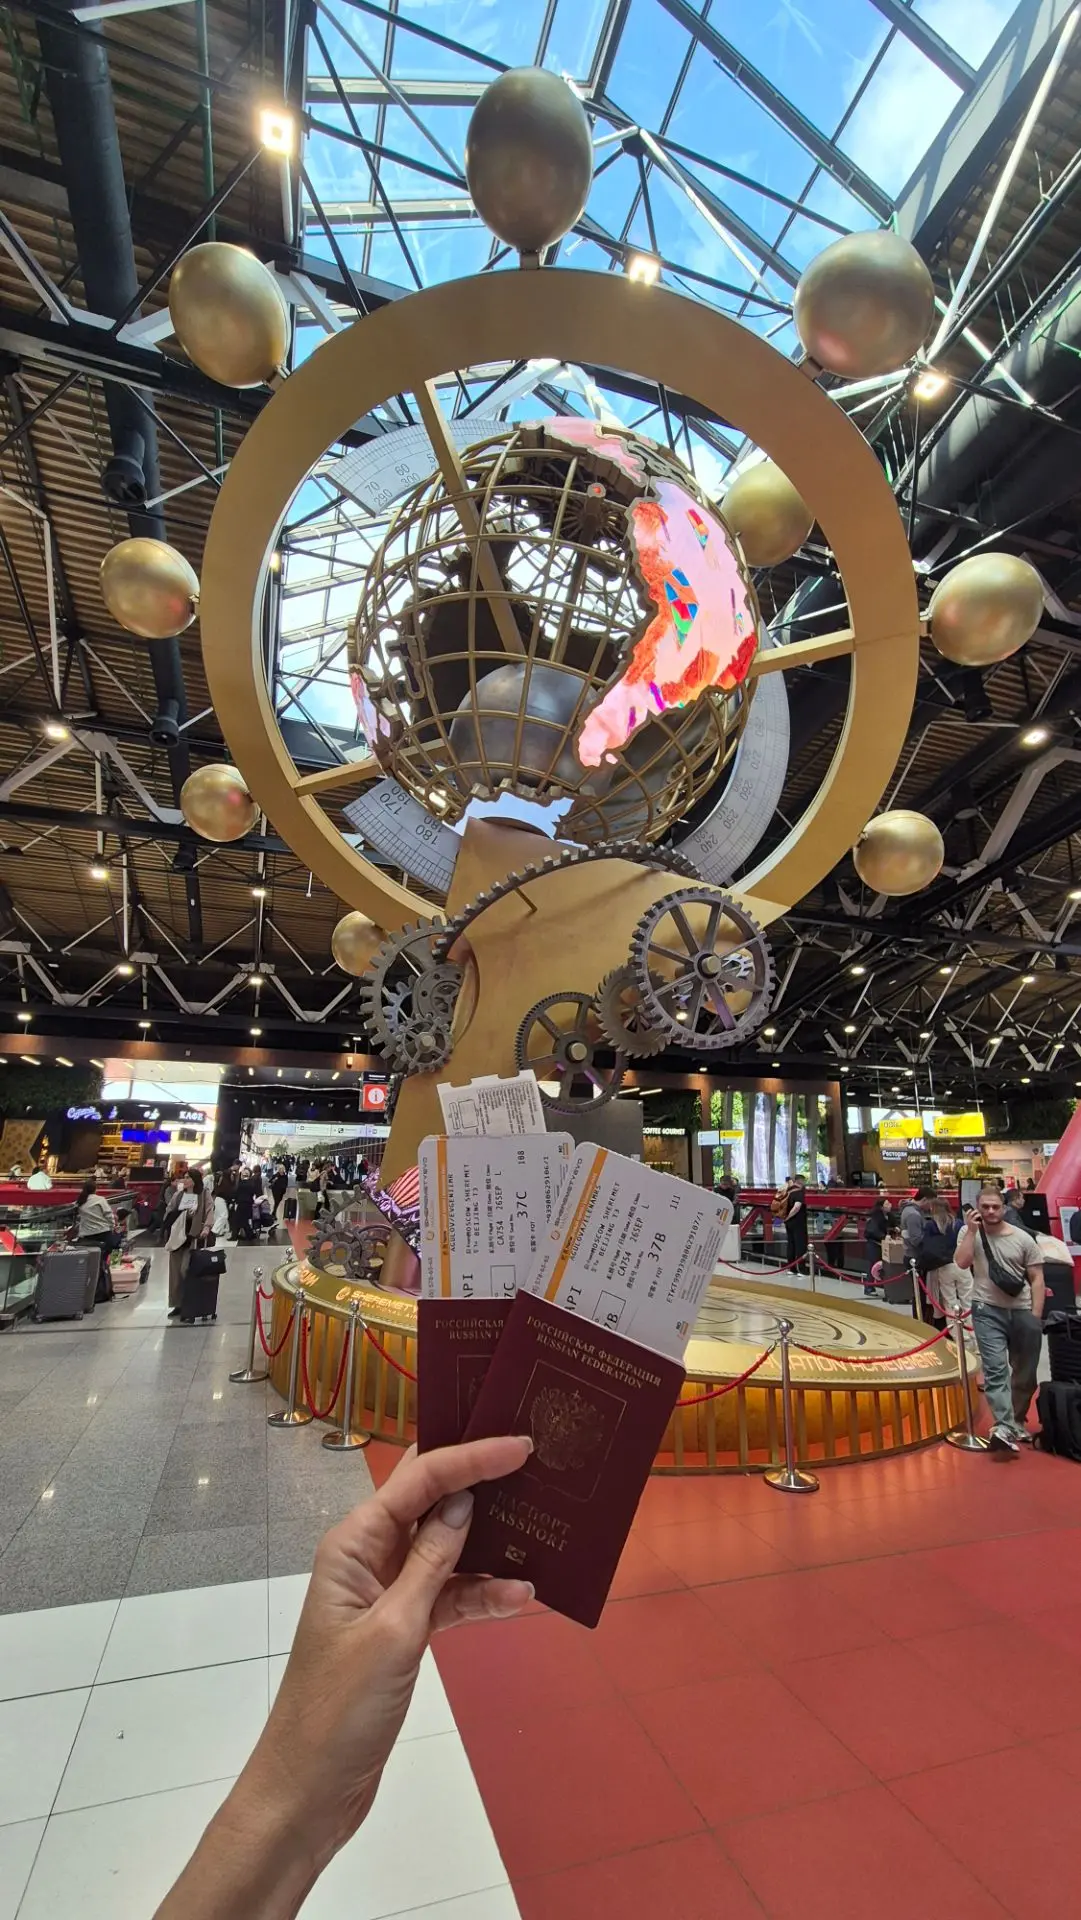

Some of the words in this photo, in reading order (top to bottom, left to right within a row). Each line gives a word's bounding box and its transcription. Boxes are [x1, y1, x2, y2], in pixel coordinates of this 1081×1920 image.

[394, 463, 410, 476] 60
[400, 472, 421, 488] 300
[364, 481, 380, 495] 70
[373, 489, 393, 507] 290
[379, 793, 403, 816] 170
[391, 785, 412, 806] 190
[415, 824, 439, 846] 180
[423, 815, 443, 833] 180
[494, 1185, 503, 1209] 26SEP
[515, 1190, 528, 1218] 37C
[601, 1180, 621, 1220] SHEREMET
[472, 1201, 480, 1236] BEIJING
[495, 1220, 504, 1245] CA754
[598, 1222, 615, 1256] BEIJING
[616, 1250, 632, 1277] CA754
[629, 1216, 645, 1242] 26SEP
[646, 1230, 667, 1262] 37B
[435, 1319, 505, 1330] РОССИЙСКАЯ
[449, 1330, 493, 1341] RUSSIAN
[527, 1315, 595, 1354] РОССИЙСКАЯ
[598, 1348, 662, 1388] ФЕДЕРАЦИЯ
[536, 1334, 579, 1360] RUSSIAN
[580, 1354, 644, 1390] FEDERATION
[755, 1353, 848, 1373] AVATION
[488, 1503, 569, 1552] PASSPORT
